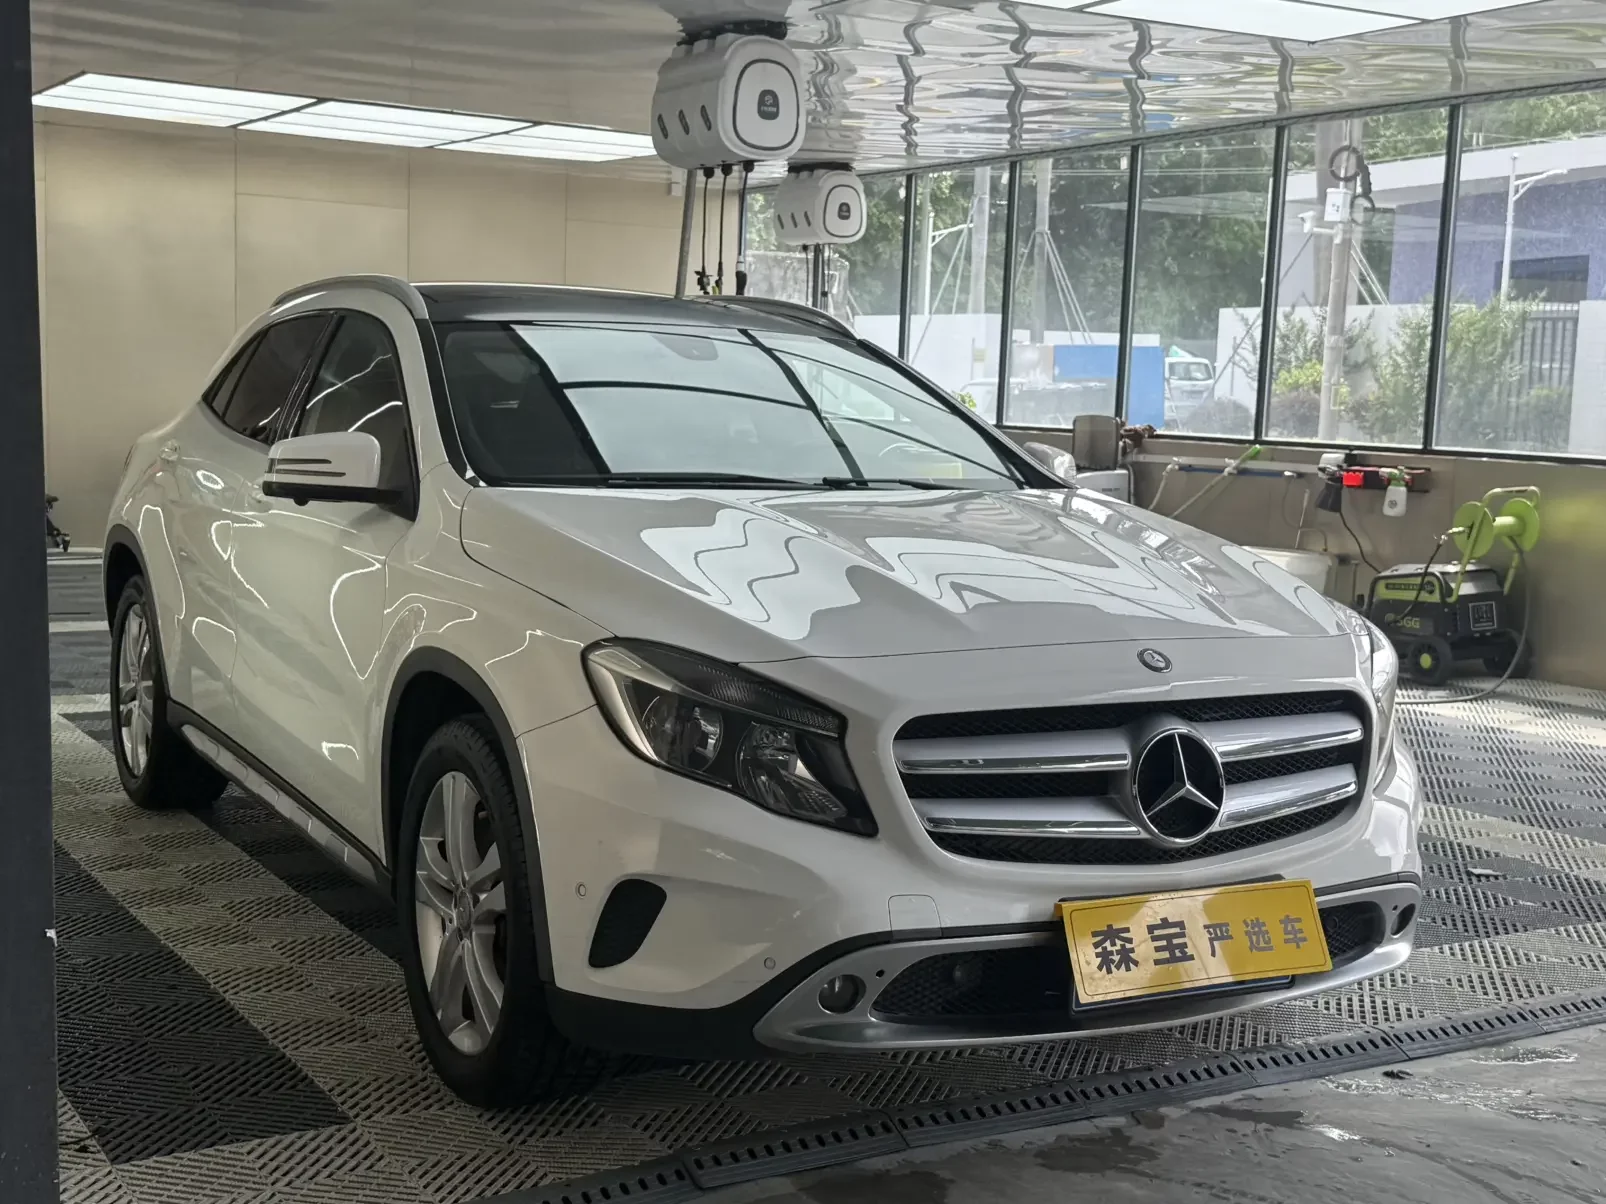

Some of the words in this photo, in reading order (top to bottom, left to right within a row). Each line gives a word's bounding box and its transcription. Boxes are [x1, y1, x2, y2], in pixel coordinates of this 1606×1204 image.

[1091, 915, 1308, 975] 森宝严选车
